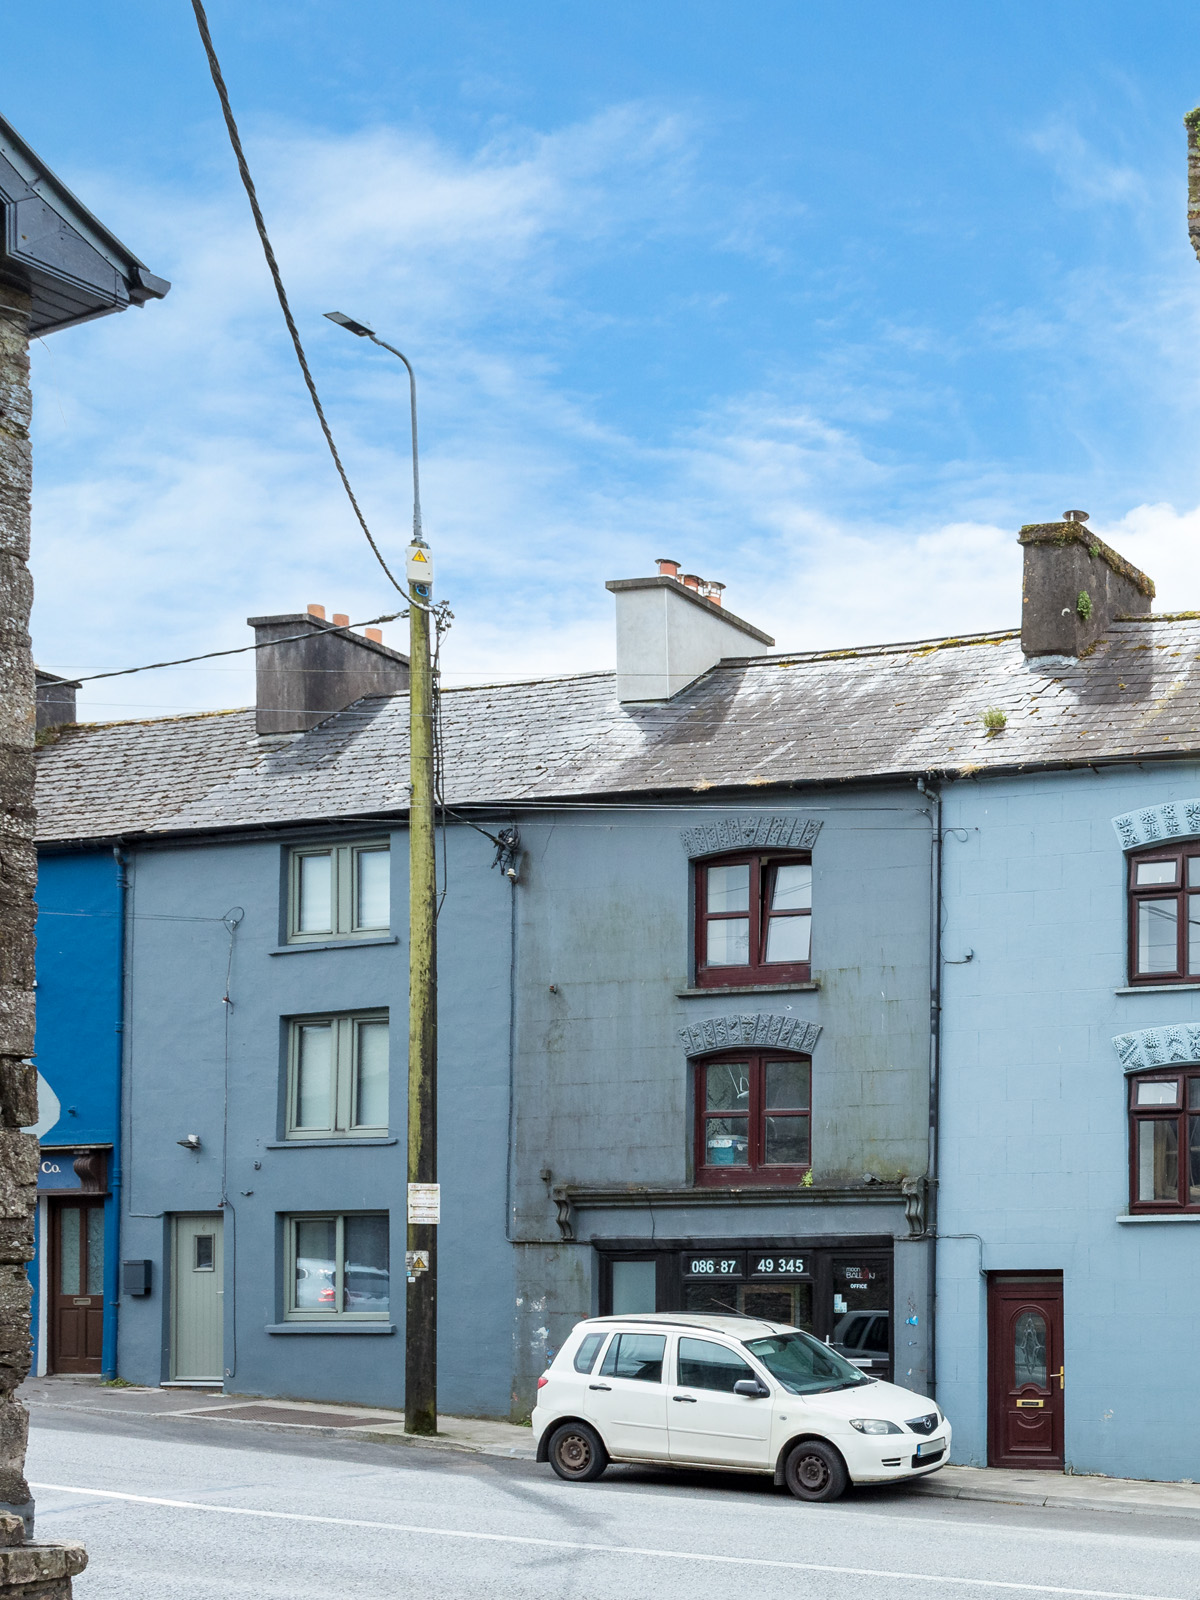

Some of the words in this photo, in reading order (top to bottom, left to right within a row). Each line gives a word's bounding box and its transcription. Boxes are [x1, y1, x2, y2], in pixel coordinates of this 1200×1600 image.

[41, 1161, 61, 1174] Co.
[757, 1259, 774, 1272] 49
[778, 1259, 804, 1272] 345
